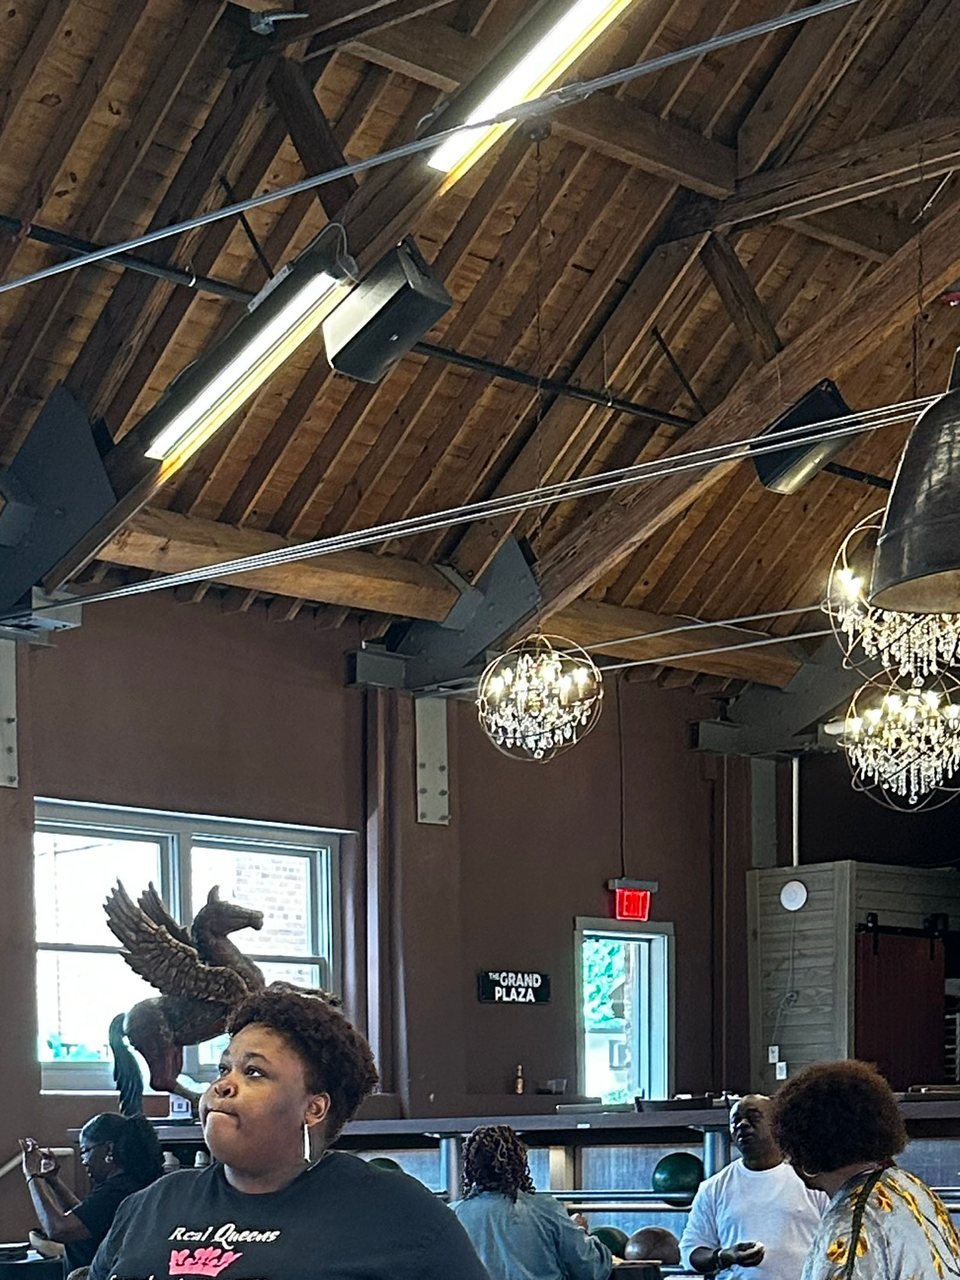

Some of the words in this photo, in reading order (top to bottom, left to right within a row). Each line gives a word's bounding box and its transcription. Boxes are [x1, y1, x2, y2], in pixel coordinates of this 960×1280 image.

[488, 972, 500, 980] THE
[500, 971, 542, 988] GRAND
[494, 986, 536, 1002] PLAZA
[168, 1226, 211, 1242] Real
[212, 1223, 281, 1250] Queens
